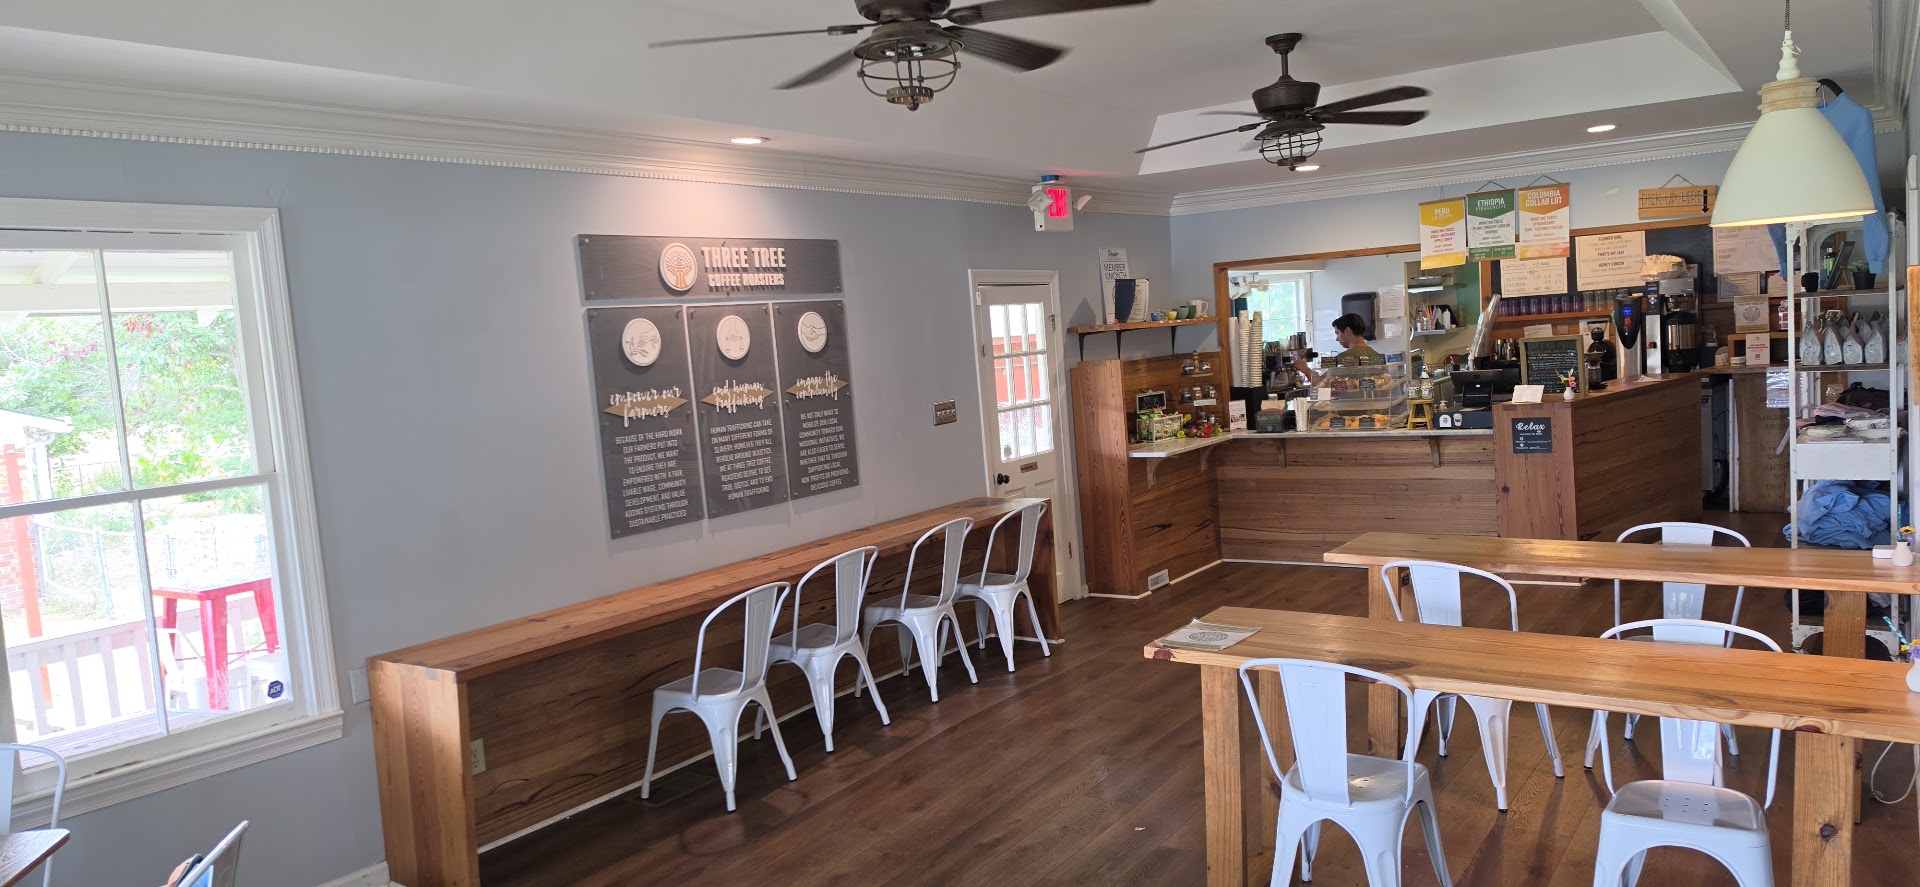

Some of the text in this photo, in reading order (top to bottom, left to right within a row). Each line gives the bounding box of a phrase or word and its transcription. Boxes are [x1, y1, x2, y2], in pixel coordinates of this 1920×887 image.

[1528, 190, 1560, 199] COLOMBIA
[1641, 191, 1701, 208] PICK UP HERE
[1478, 198, 1504, 207] ETHIOPIA
[1526, 198, 1549, 206] COLLAB
[1435, 207, 1449, 216] PERU
[701, 247, 786, 268] THREE TREE
[708, 274, 784, 286] COFFEE ROASTERS
[825, 370, 838, 386] the
[662, 386, 682, 398] our
[713, 380, 764, 396] end human
[716, 394, 764, 413] trafficking
[624, 403, 672, 427] farmers
[727, 422, 752, 432] TRAFFICKING
[1516, 422, 1546, 430] Relax
[616, 435, 637, 444] BECAUSE
[655, 431, 668, 439] HARD
[718, 435, 731, 443] MANY
[731, 431, 752, 441] DIFFERENT
[799, 430, 820, 438] COMMUNITY
[634, 443, 656, 452] FARMERS
[667, 440, 678, 448] INTO
[734, 441, 754, 450] HOWEVER
[799, 438, 818, 447] MISSIONAL
[624, 456, 633, 464] THE
[666, 450, 679, 458] WANT
[716, 451, 751, 463] REVOLVE AROUND
[832, 451, 847, 459] THROUGH
[635, 464, 654, 473] ENSURE
[655, 462, 667, 470] THEY
[667, 460, 676, 469] ARE
[732, 461, 745, 470] THREE
[757, 457, 771, 466] COFFEE
[808, 464, 830, 474] SUPPORTING
[623, 475, 653, 486] EMPOWERED
[655, 473, 666, 481] WITH
[721, 472, 742, 481] ROASTERS
[743, 470, 757, 479] DESIRE
[810, 474, 824, 482] PROFITS
[831, 468, 849, 478] PROVIDING
[622, 479, 686, 496] LIVABLE COMMUNITY
[733, 481, 750, 490] JUSTICE
[811, 482, 829, 491] DELICIOUS
[661, 489, 686, 500] AND VALUE
[728, 486, 770, 500] HUMAN TRAFFICKING
[625, 499, 688, 517] ADDING SYSTEMS THROUGH
[629, 510, 687, 528] SUSTAINABLE PRACTICES
